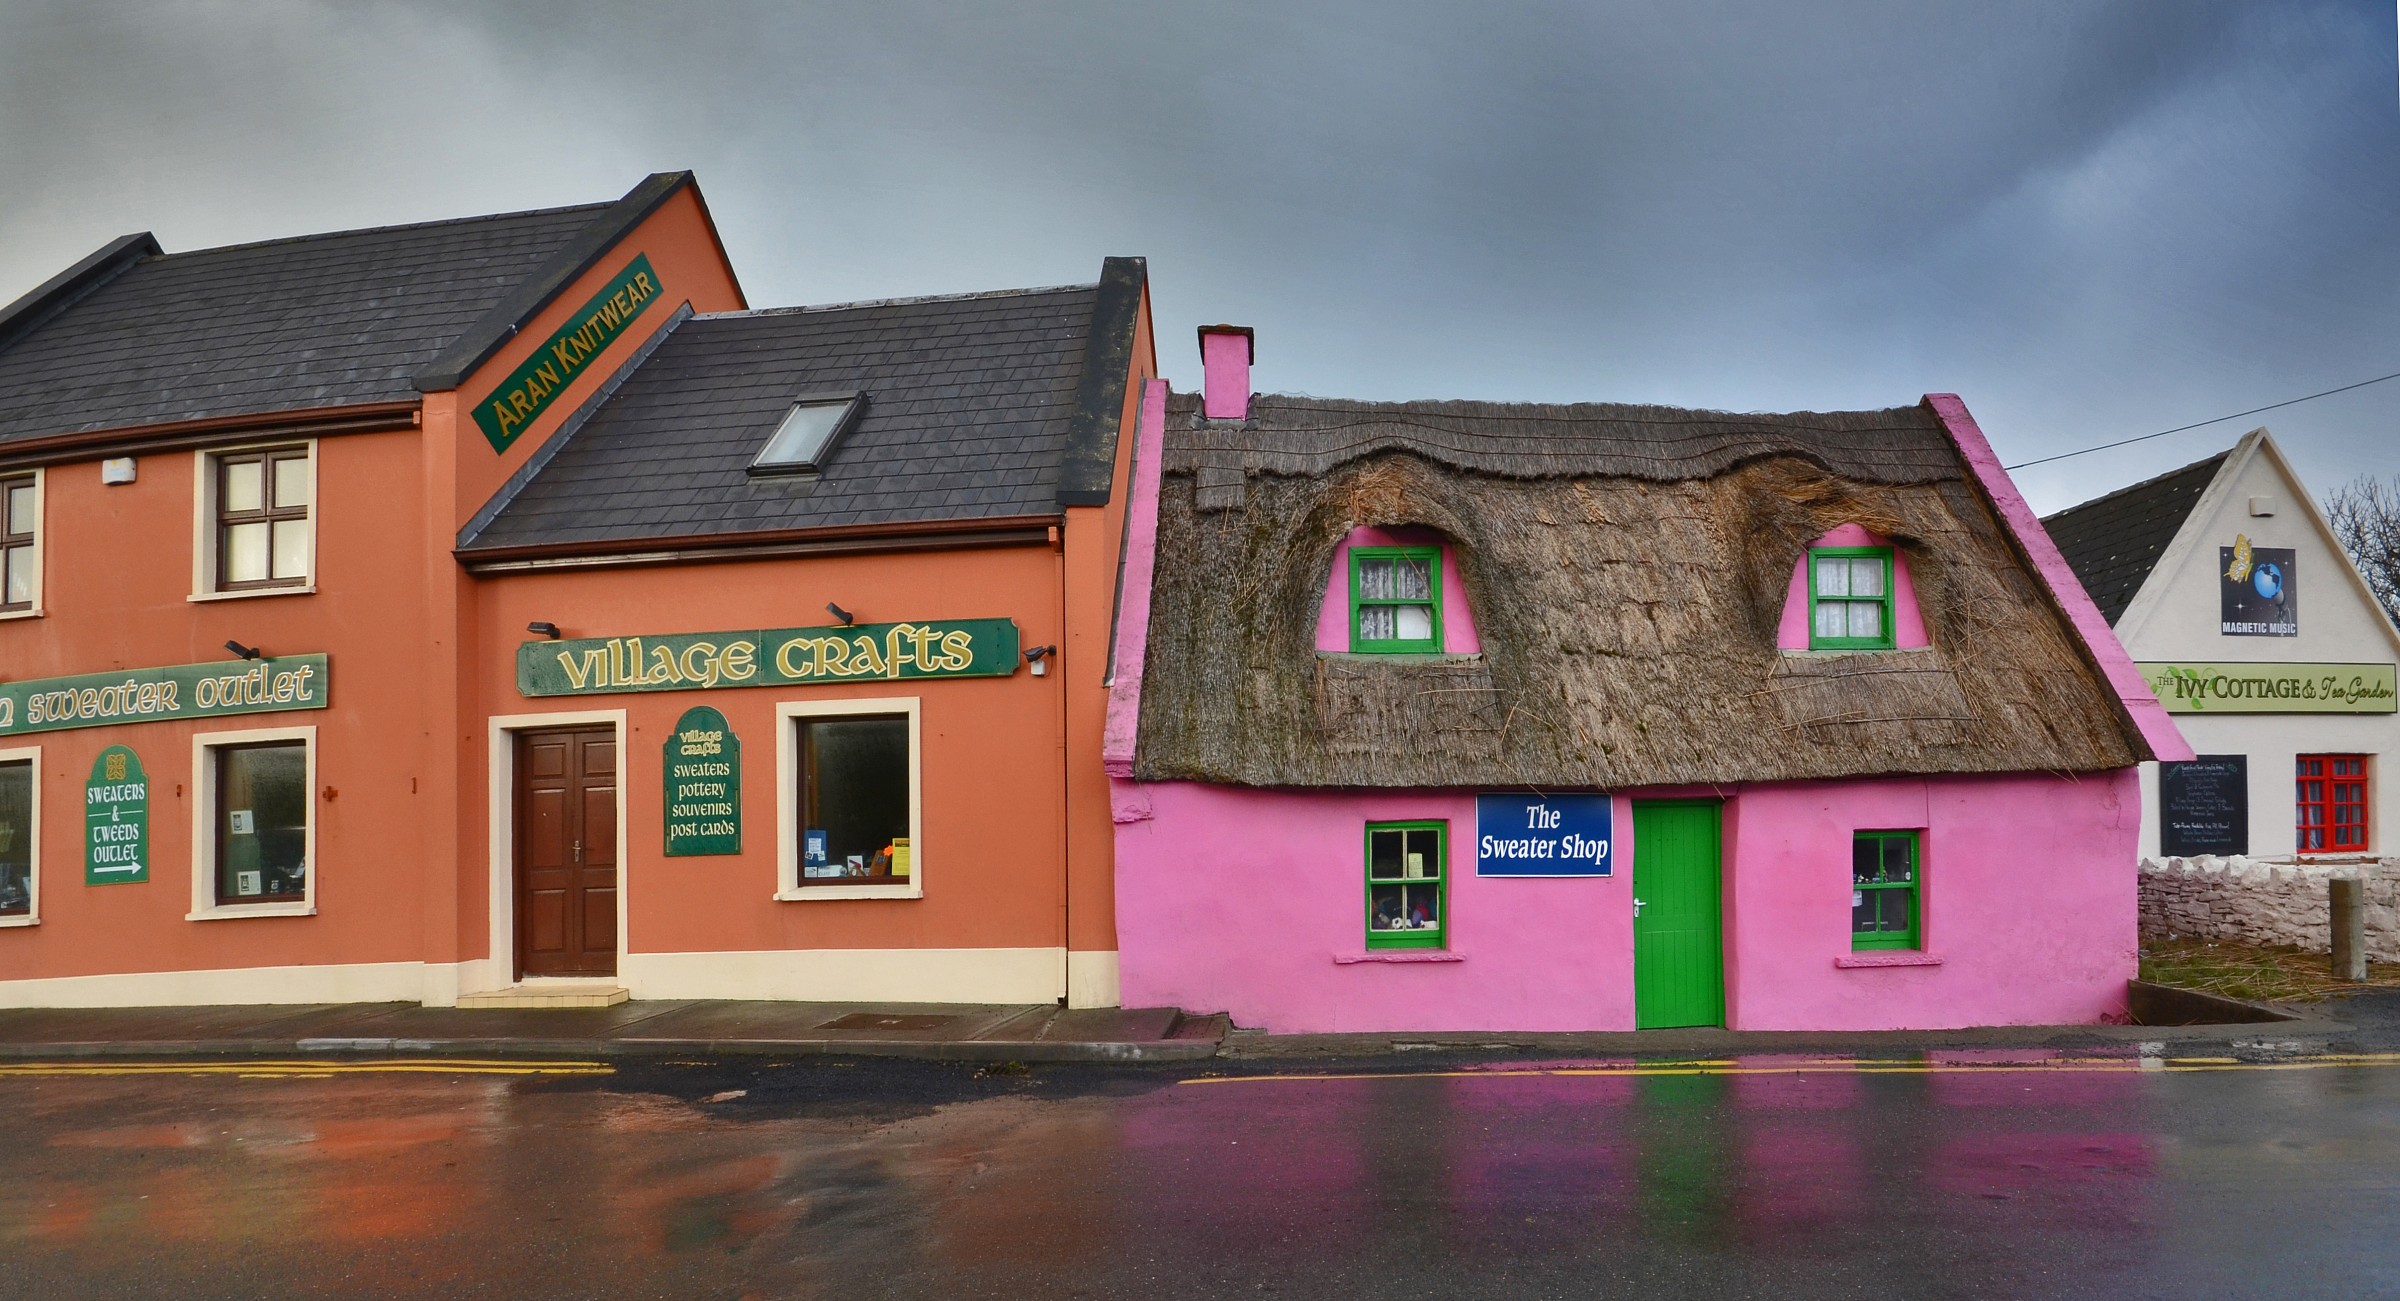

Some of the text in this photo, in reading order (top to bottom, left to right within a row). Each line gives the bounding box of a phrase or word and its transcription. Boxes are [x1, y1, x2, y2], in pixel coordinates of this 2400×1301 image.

[493, 271, 654, 437] ARAN KNITWEAR
[2222, 621, 2296, 634] MAGNETIC MUSIC
[2156, 675, 2394, 705] THE IVY COTTAGE & Tea Garden
[87, 783, 145, 805] SWEATERS
[111, 804, 120, 821] &
[1526, 803, 1561, 829] The
[93, 823, 139, 843] TWEEDS
[93, 843, 139, 863] OUTLET
[1480, 833, 1609, 865] Sweater Shop
